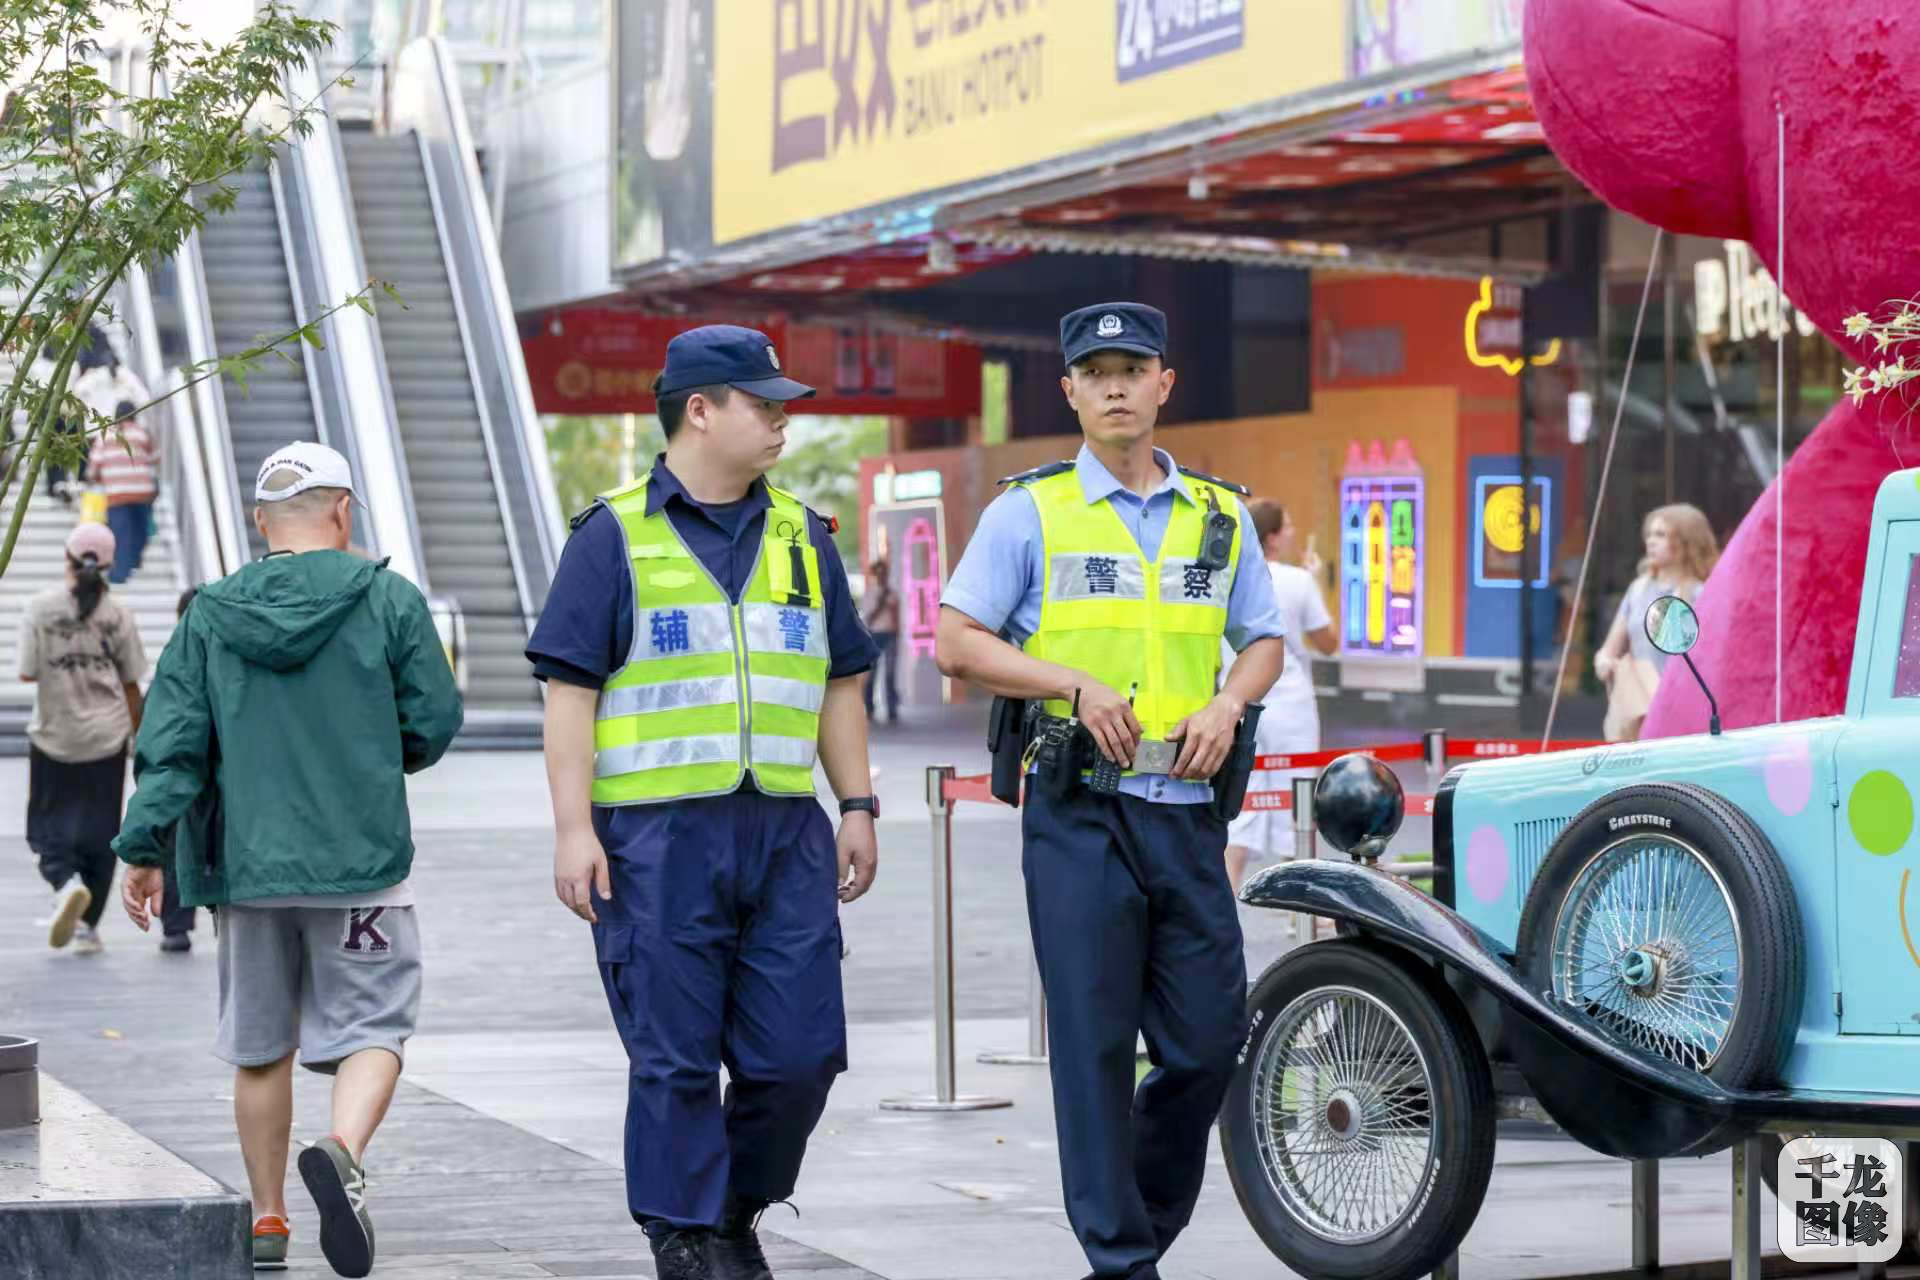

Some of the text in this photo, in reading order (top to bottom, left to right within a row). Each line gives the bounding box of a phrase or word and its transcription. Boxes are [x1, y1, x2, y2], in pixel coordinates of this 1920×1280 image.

[904, 34, 1044, 137] BANU HOTPOT
[1084, 556, 1212, 599] 警 察
[651, 608, 810, 652] 辅 警
[343, 906, 388, 950] K
